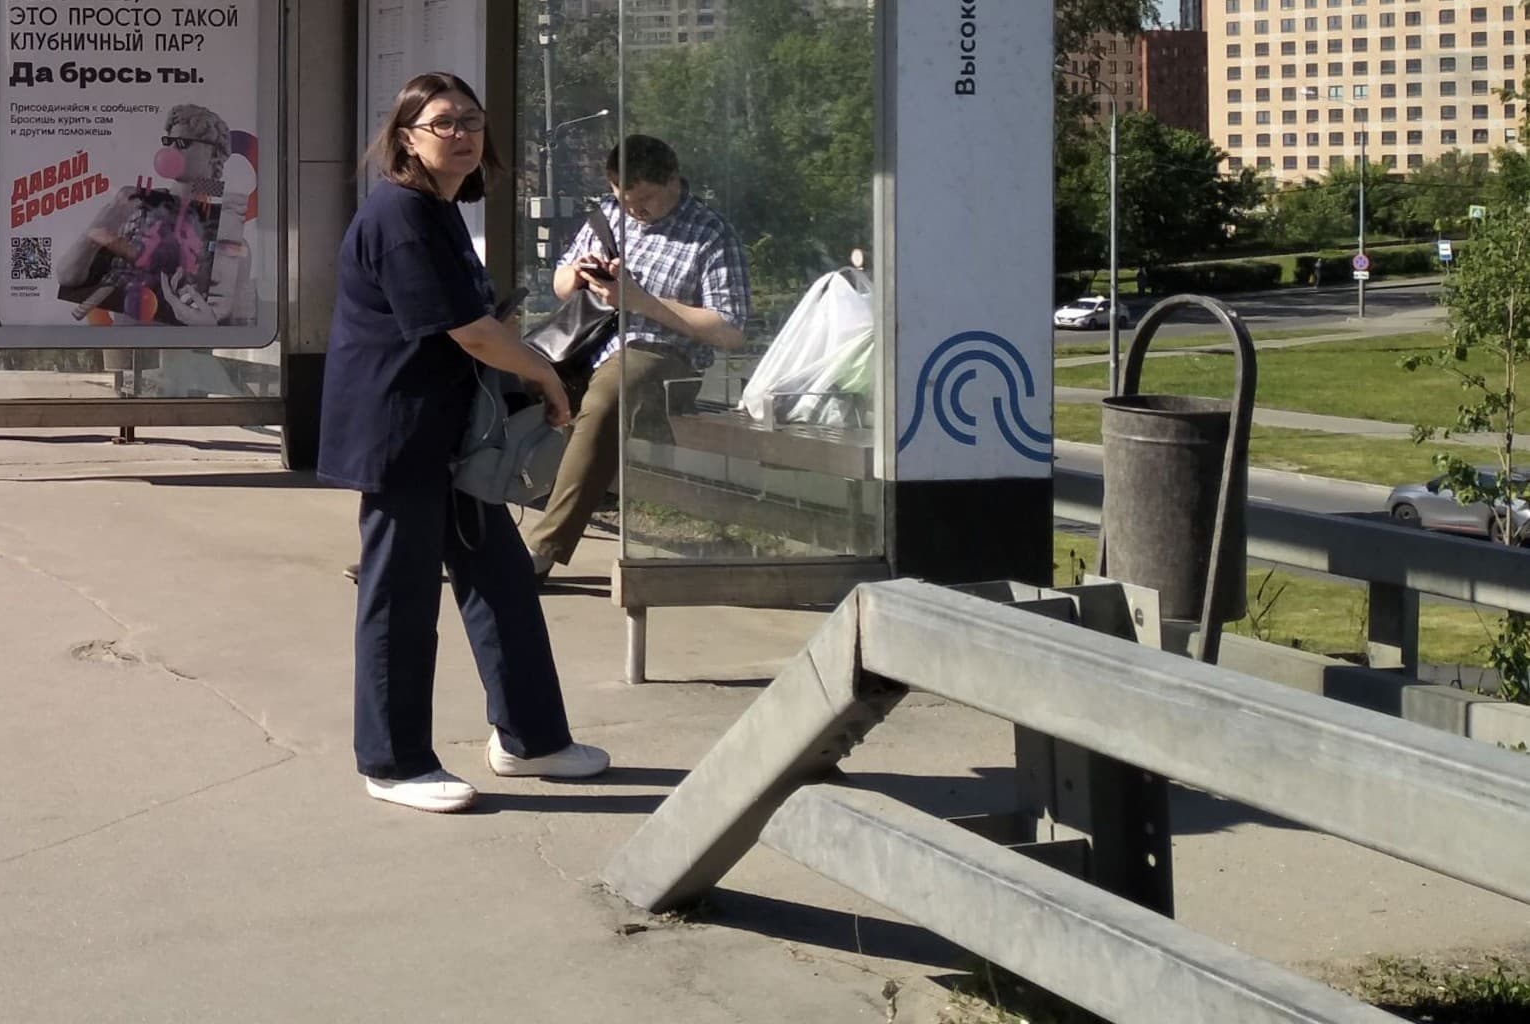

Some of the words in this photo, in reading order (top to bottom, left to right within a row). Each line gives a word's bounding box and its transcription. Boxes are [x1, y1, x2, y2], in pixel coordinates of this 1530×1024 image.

[10, 6, 58, 26] ЭТО
[69, 7, 162, 27] ПРОСТО
[171, 5, 238, 27] ТАКОЙ
[155, 34, 205, 52] ПАР?
[9, 61, 54, 87] Да
[60, 61, 152, 88] брось
[157, 67, 205, 84] ты.
[10, 102, 90, 114] Присоединяйся
[10, 115, 56, 125] Бросишь
[58, 117, 92, 126] курить
[19, 129, 55, 137] другим
[10, 150, 89, 205] ДАВАЙ
[10, 173, 110, 229] БРОСАТЬ
